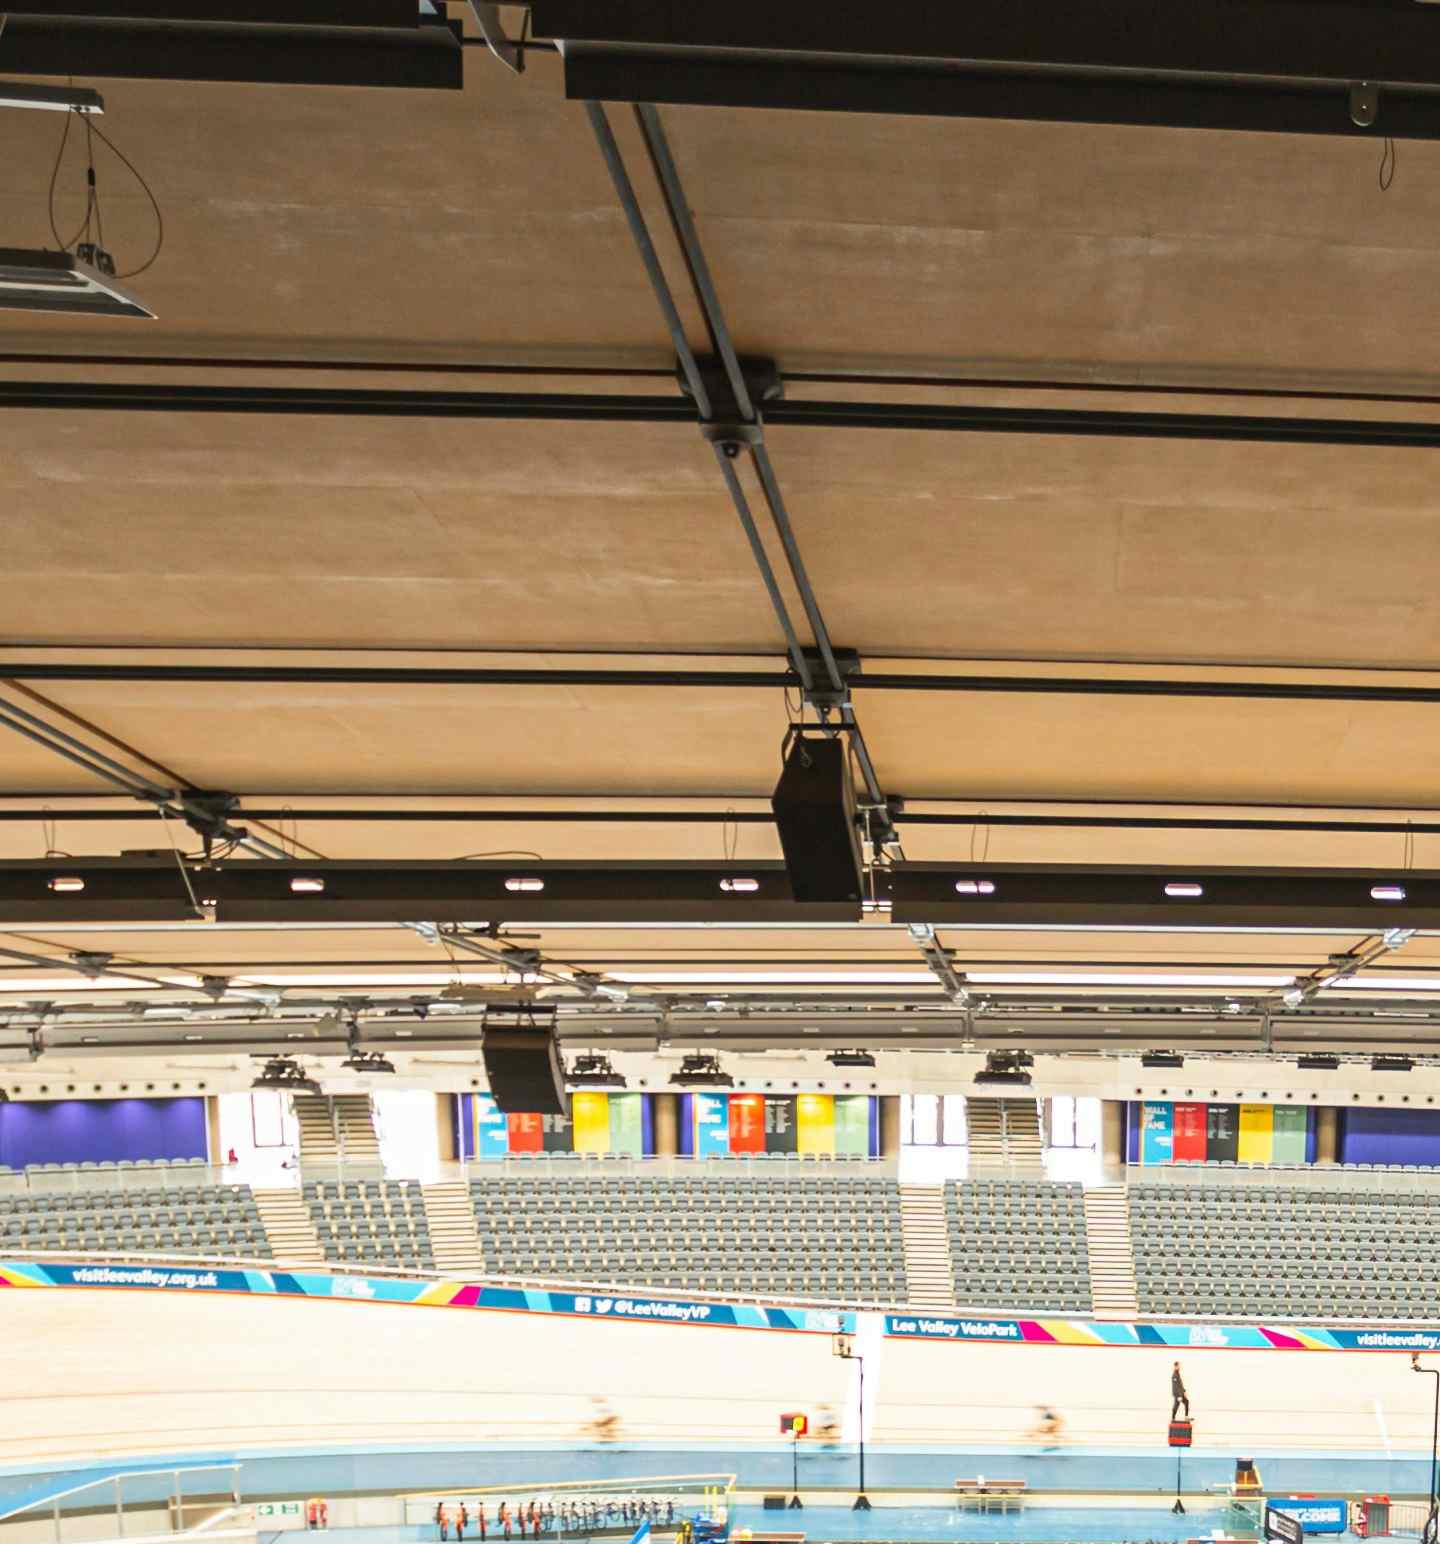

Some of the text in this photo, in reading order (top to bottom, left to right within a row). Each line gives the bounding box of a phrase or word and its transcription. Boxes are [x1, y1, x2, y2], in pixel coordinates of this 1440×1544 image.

[72, 1268, 217, 1288] visitleevalley.org.uk
[892, 1318, 1017, 1337] Lee Valley VeloPark
